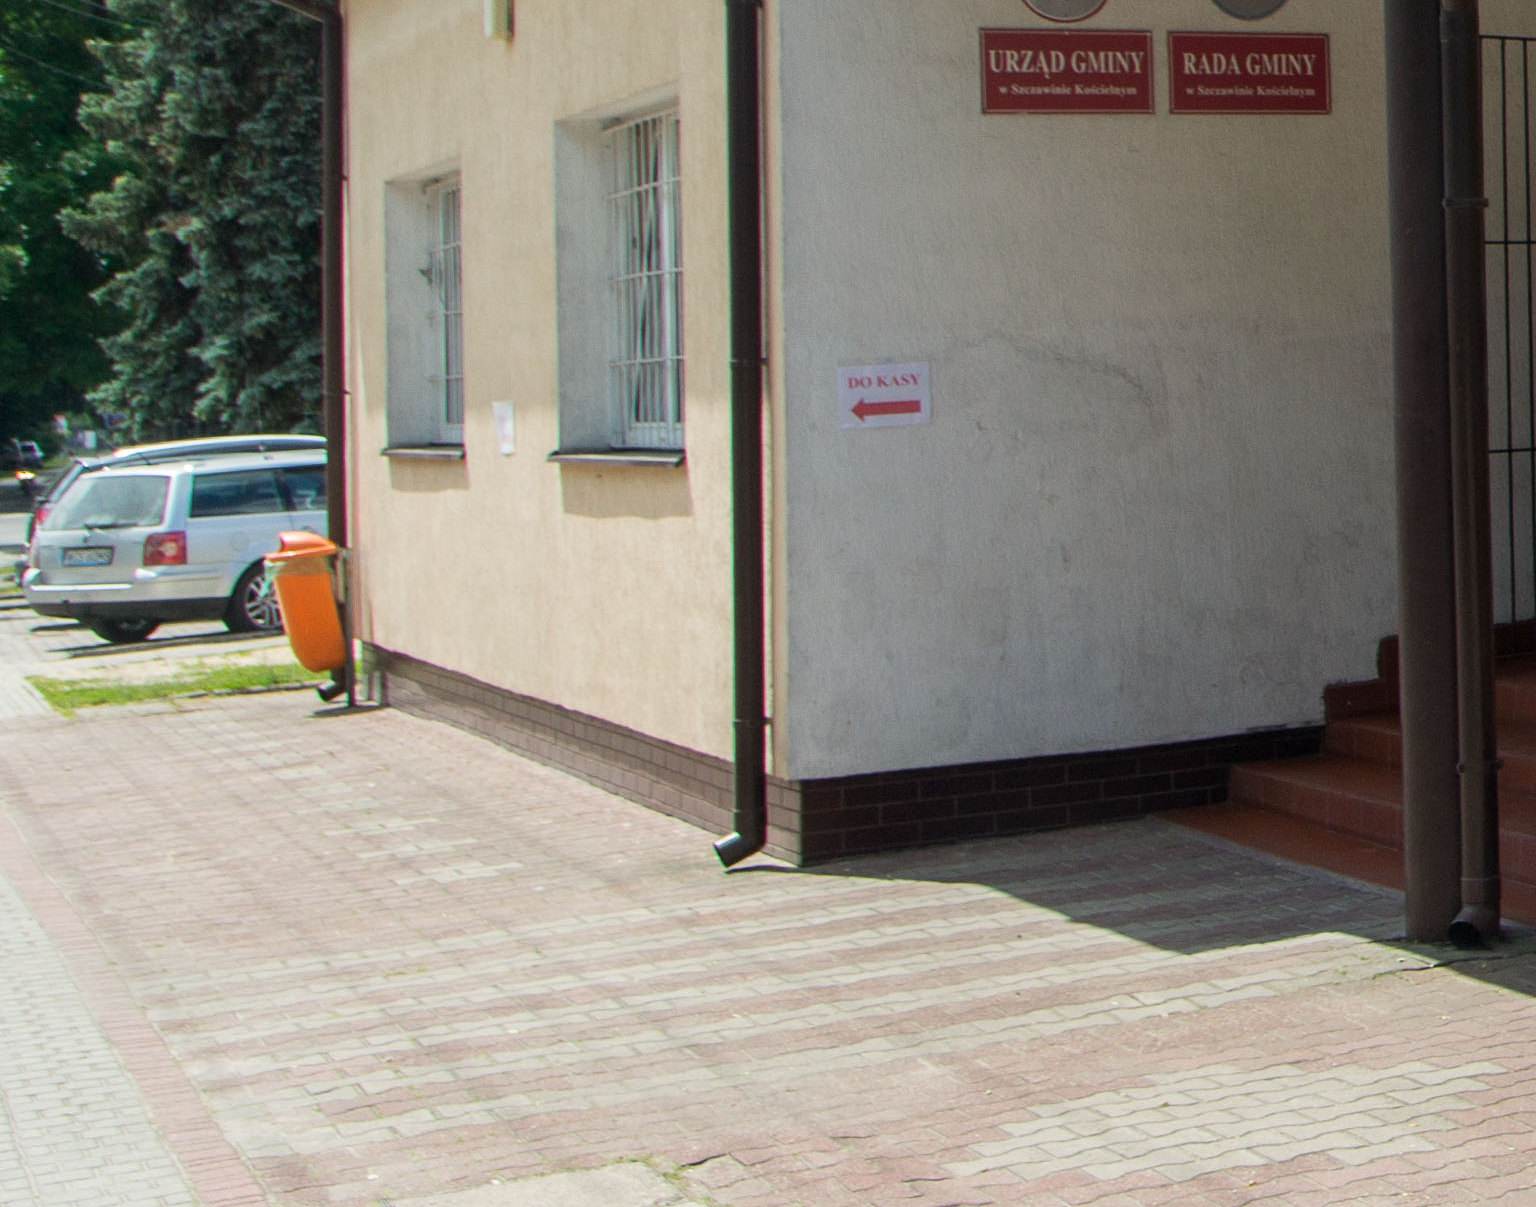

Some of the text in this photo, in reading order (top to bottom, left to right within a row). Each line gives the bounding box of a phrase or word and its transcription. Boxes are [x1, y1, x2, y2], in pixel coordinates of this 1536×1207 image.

[988, 49, 1145, 79] URZĄD GMINY
[1182, 52, 1317, 75] RADA GMINY
[847, 373, 921, 389] DO KASY
